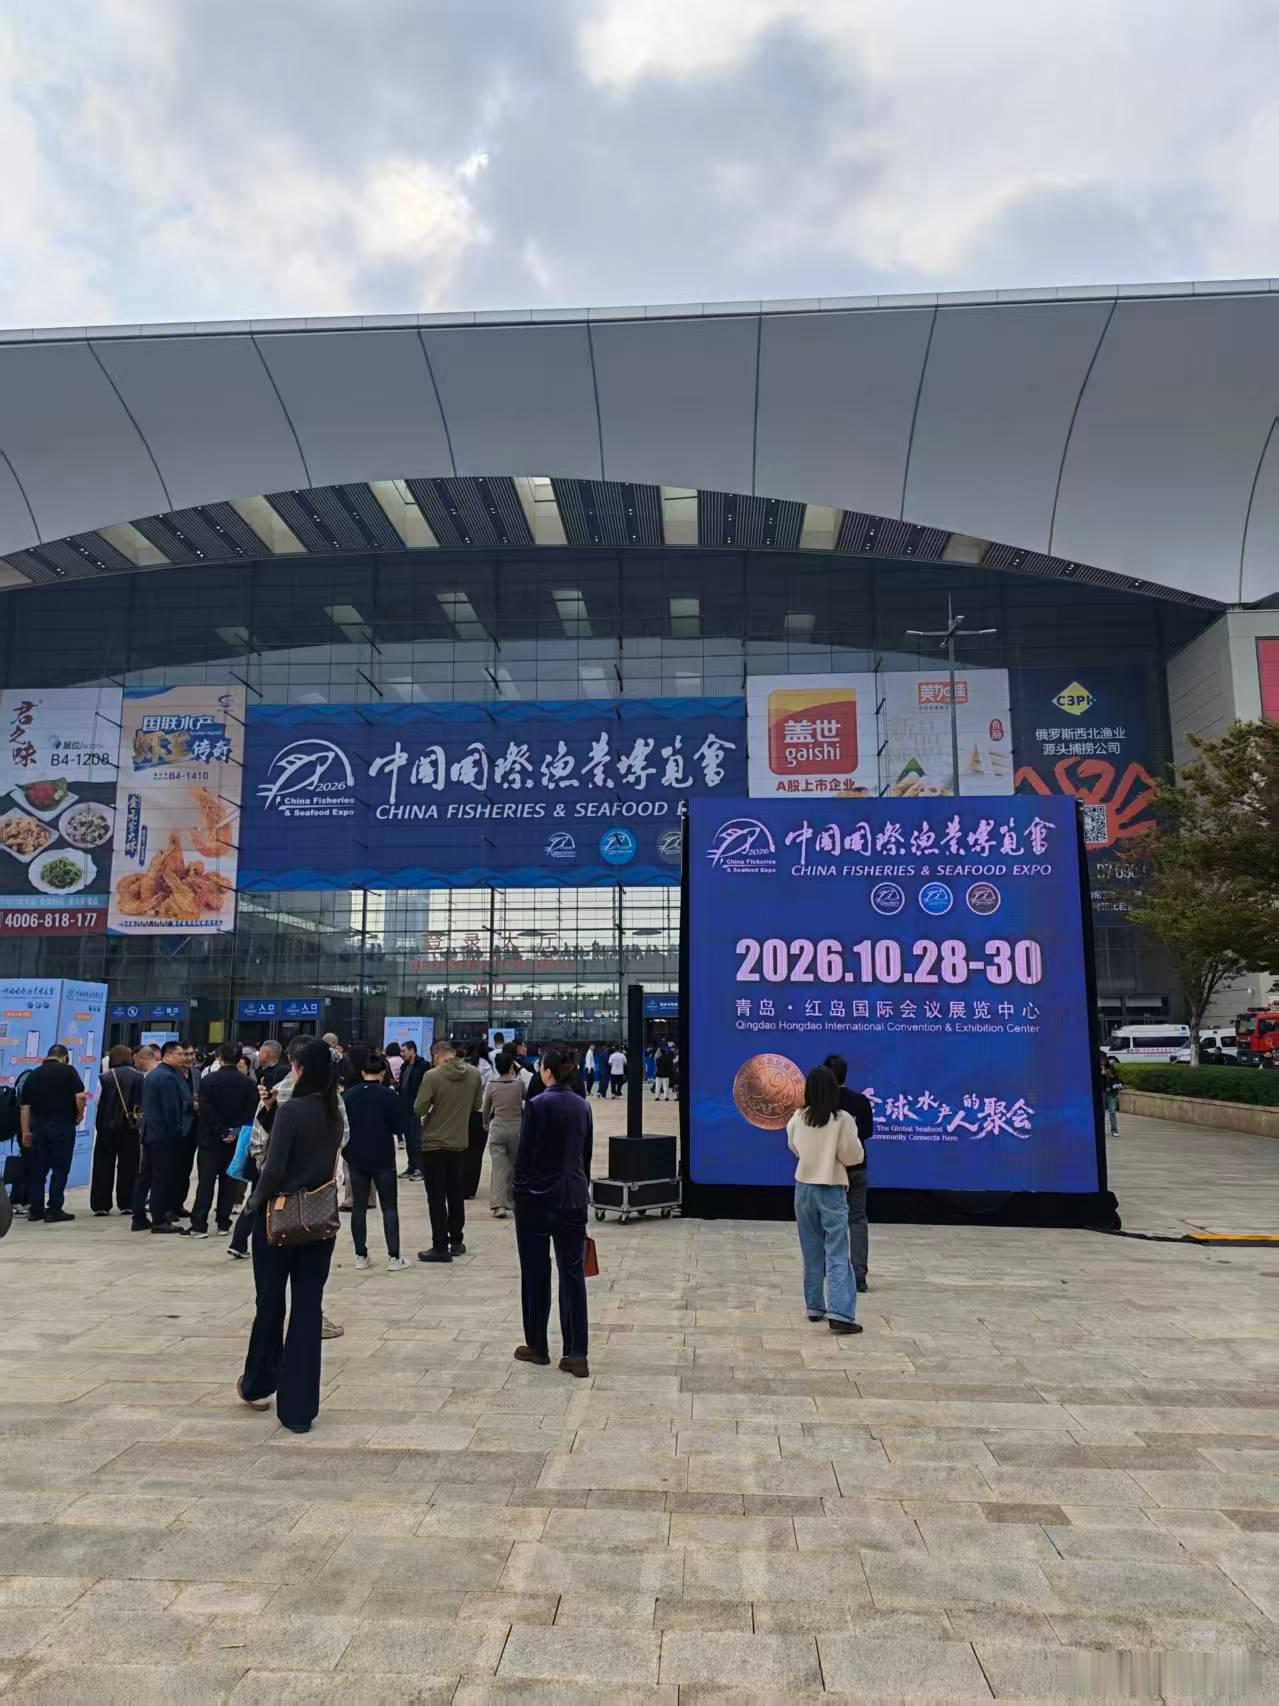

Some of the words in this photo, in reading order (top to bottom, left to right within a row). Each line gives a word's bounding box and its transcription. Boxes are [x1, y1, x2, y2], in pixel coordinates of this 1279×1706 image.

[143, 716, 216, 731] 国联水产
[784, 719, 841, 743] 盖世
[1035, 727, 1127, 741] 俄罗斯西北渔业
[785, 743, 841, 768] gaishi
[1042, 742, 1121, 756] 源头捕捞公司
[51, 752, 110, 767] B4-1208
[168, 771, 209, 780] B4-1410
[315, 781, 347, 792] 2026
[776, 779, 856, 793] A股上市企业
[332, 809, 355, 817] Expo
[376, 804, 439, 820] CHINA
[447, 803, 546, 819] FISHERIES
[553, 803, 566, 818] &
[574, 801, 669, 817] SEAFOOD
[748, 848, 770, 856] 2026
[791, 865, 837, 876] CHINA
[843, 864, 916, 876] FISHERIES
[920, 865, 930, 876] &
[936, 864, 1006, 876] SEAFOOD
[1013, 864, 1052, 876] EXPO
[5, 912, 97, 928] 4006-818-177
[735, 938, 1043, 985] 2026.10.28-30
[736, 1020, 776, 1032] Qingdao
[779, 1021, 823, 1032] Hongdao
[825, 1021, 884, 1032] International
[887, 1022, 942, 1032] Convention
[944, 1022, 953, 1032] &
[956, 1022, 1004, 1033] Exhibition
[1006, 1023, 1041, 1033] Center
[915, 1125, 943, 1133] Seafood
[873, 1133, 907, 1141] ommunity
